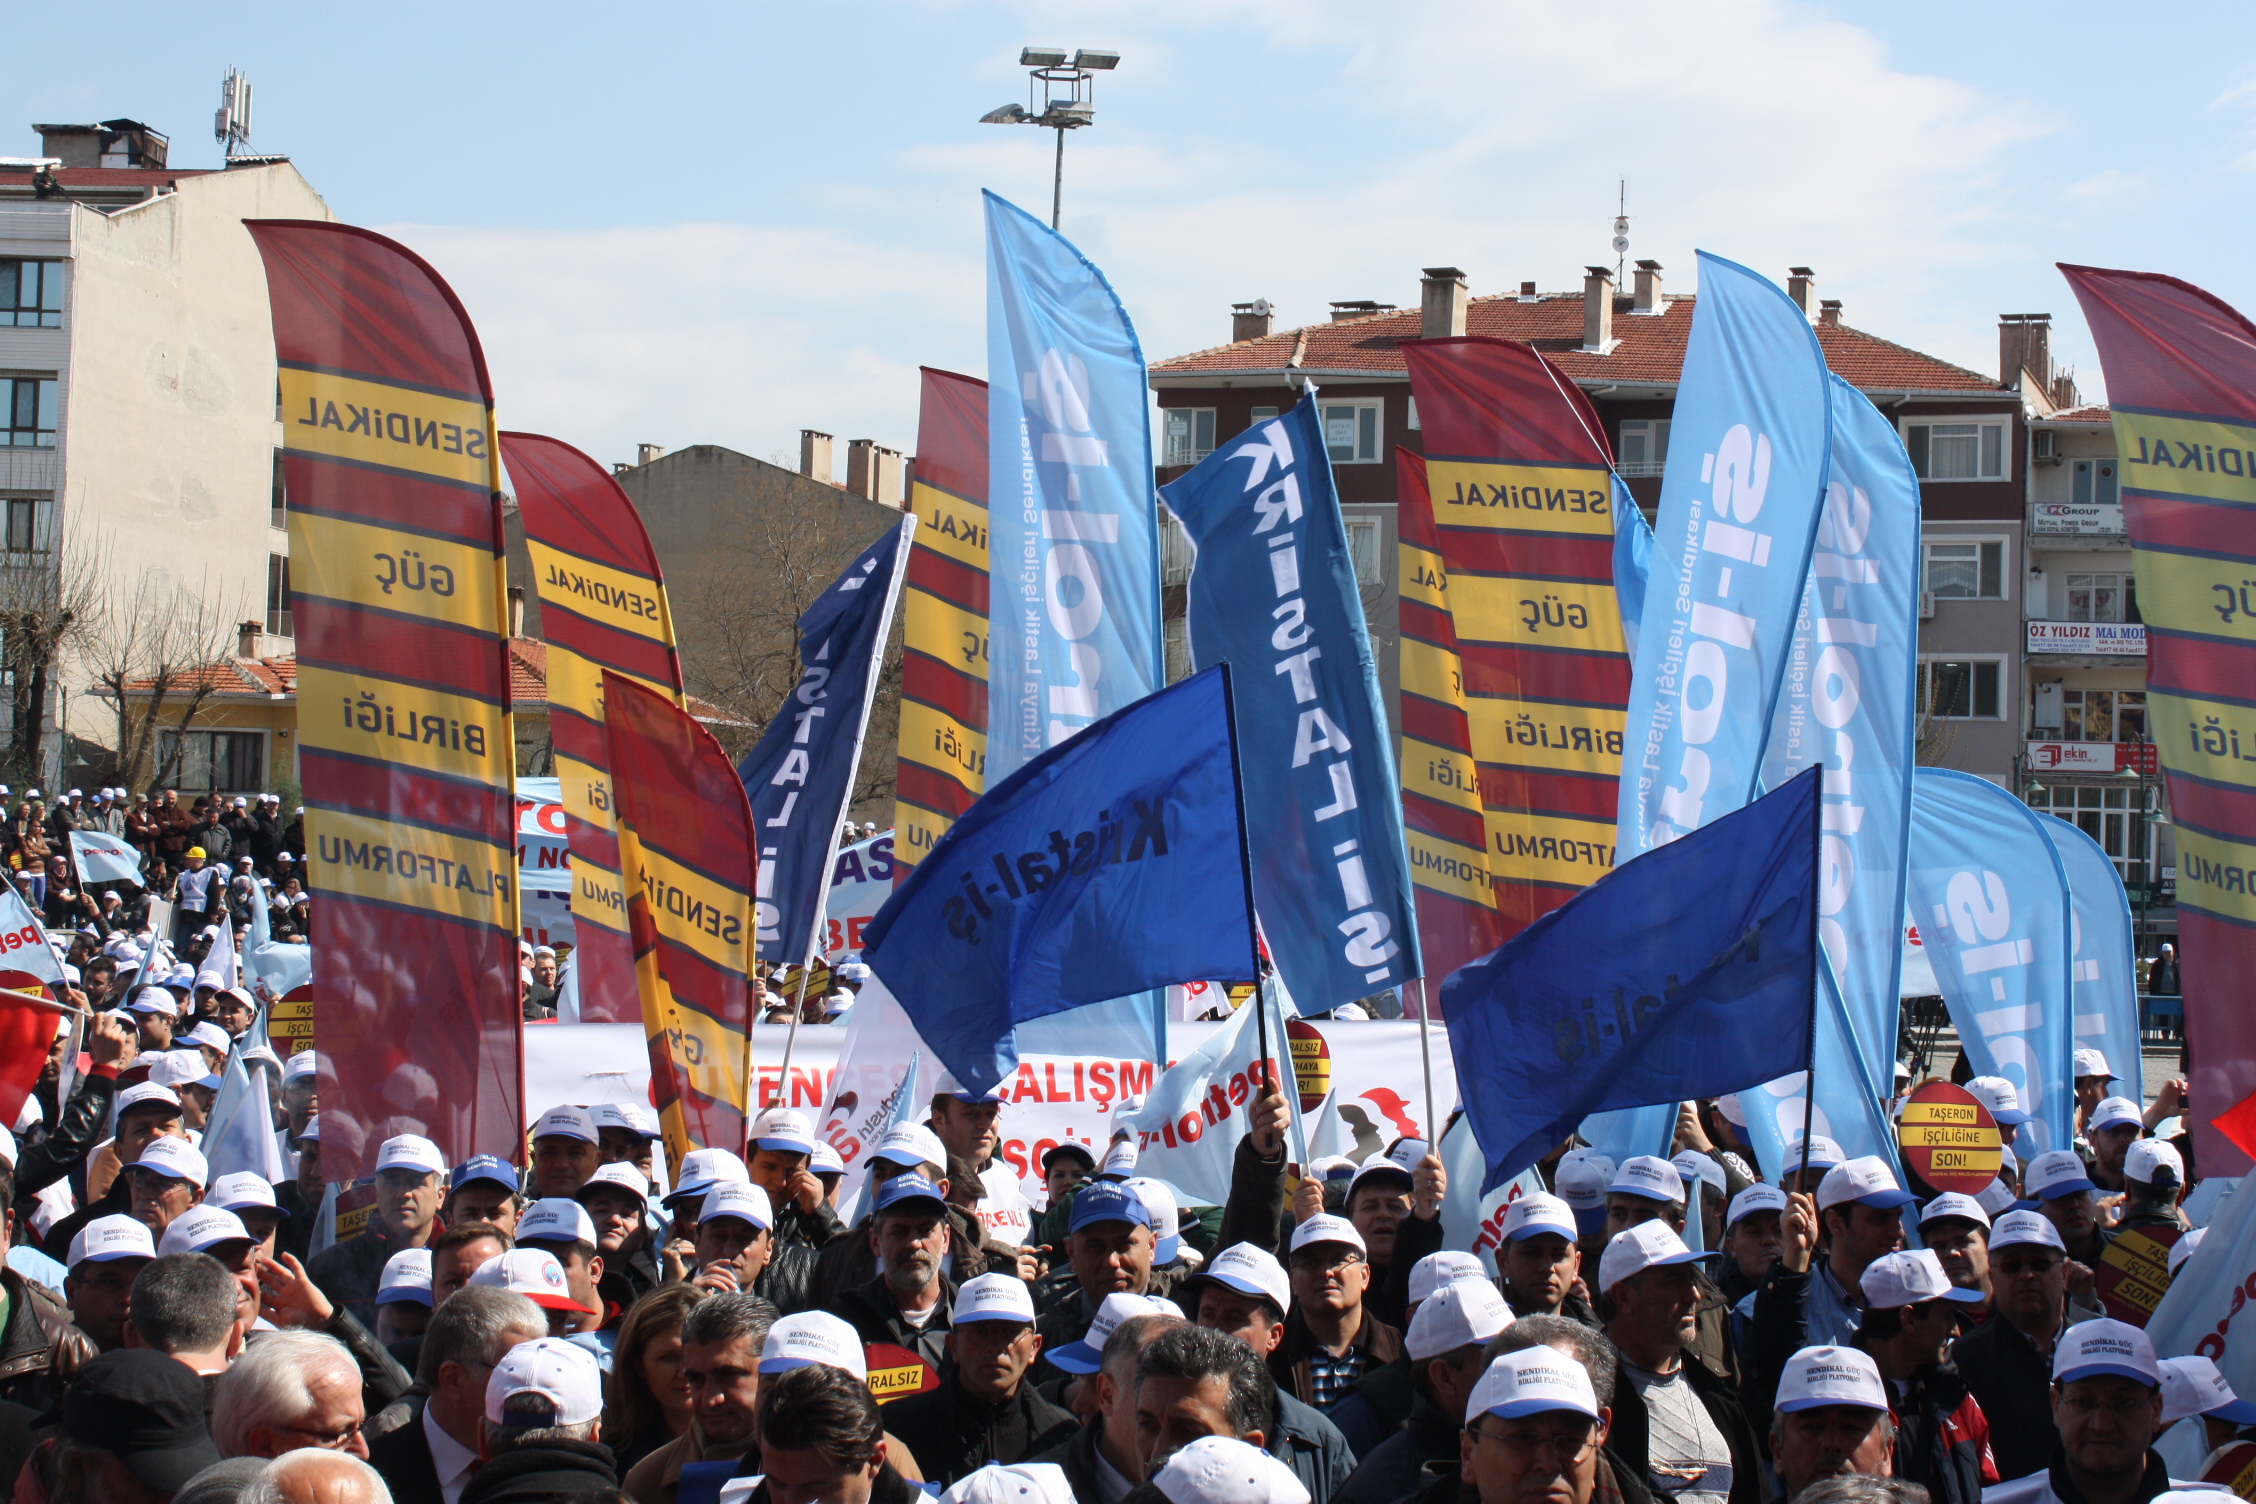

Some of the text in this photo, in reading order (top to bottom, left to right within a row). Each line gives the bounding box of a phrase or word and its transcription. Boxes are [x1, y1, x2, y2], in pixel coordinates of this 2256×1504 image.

[2030, 622, 2090, 638] ÖZ YILDIZ
[2064, 745, 2087, 758] ekin
[1929, 1107, 1974, 1122] TAŞERON
[1923, 1128, 1980, 1145] İŞÇİLİĞİNE
[1935, 1153, 1967, 1167] SON!
[1630, 1164, 1664, 1178] SENDİKAL GÜÇ
[2120, 1283, 2159, 1309] SON!
[788, 1330, 841, 1349] SENDİKAL GÜÇ
[2081, 1337, 2133, 1350] SENDİKAL GÜÇ
[2081, 1346, 2133, 1357] BİRLİĞİ PLATFORMU
[1517, 1365, 1577, 1382] SENDİKAL GÜÇ
[1806, 1363, 1861, 1375] SENDİKAL GÜÇ
[1518, 1375, 1543, 1386] BİRLİĞİ
[1807, 1373, 1861, 1383] BİRLİĞİ PLATFORMU
